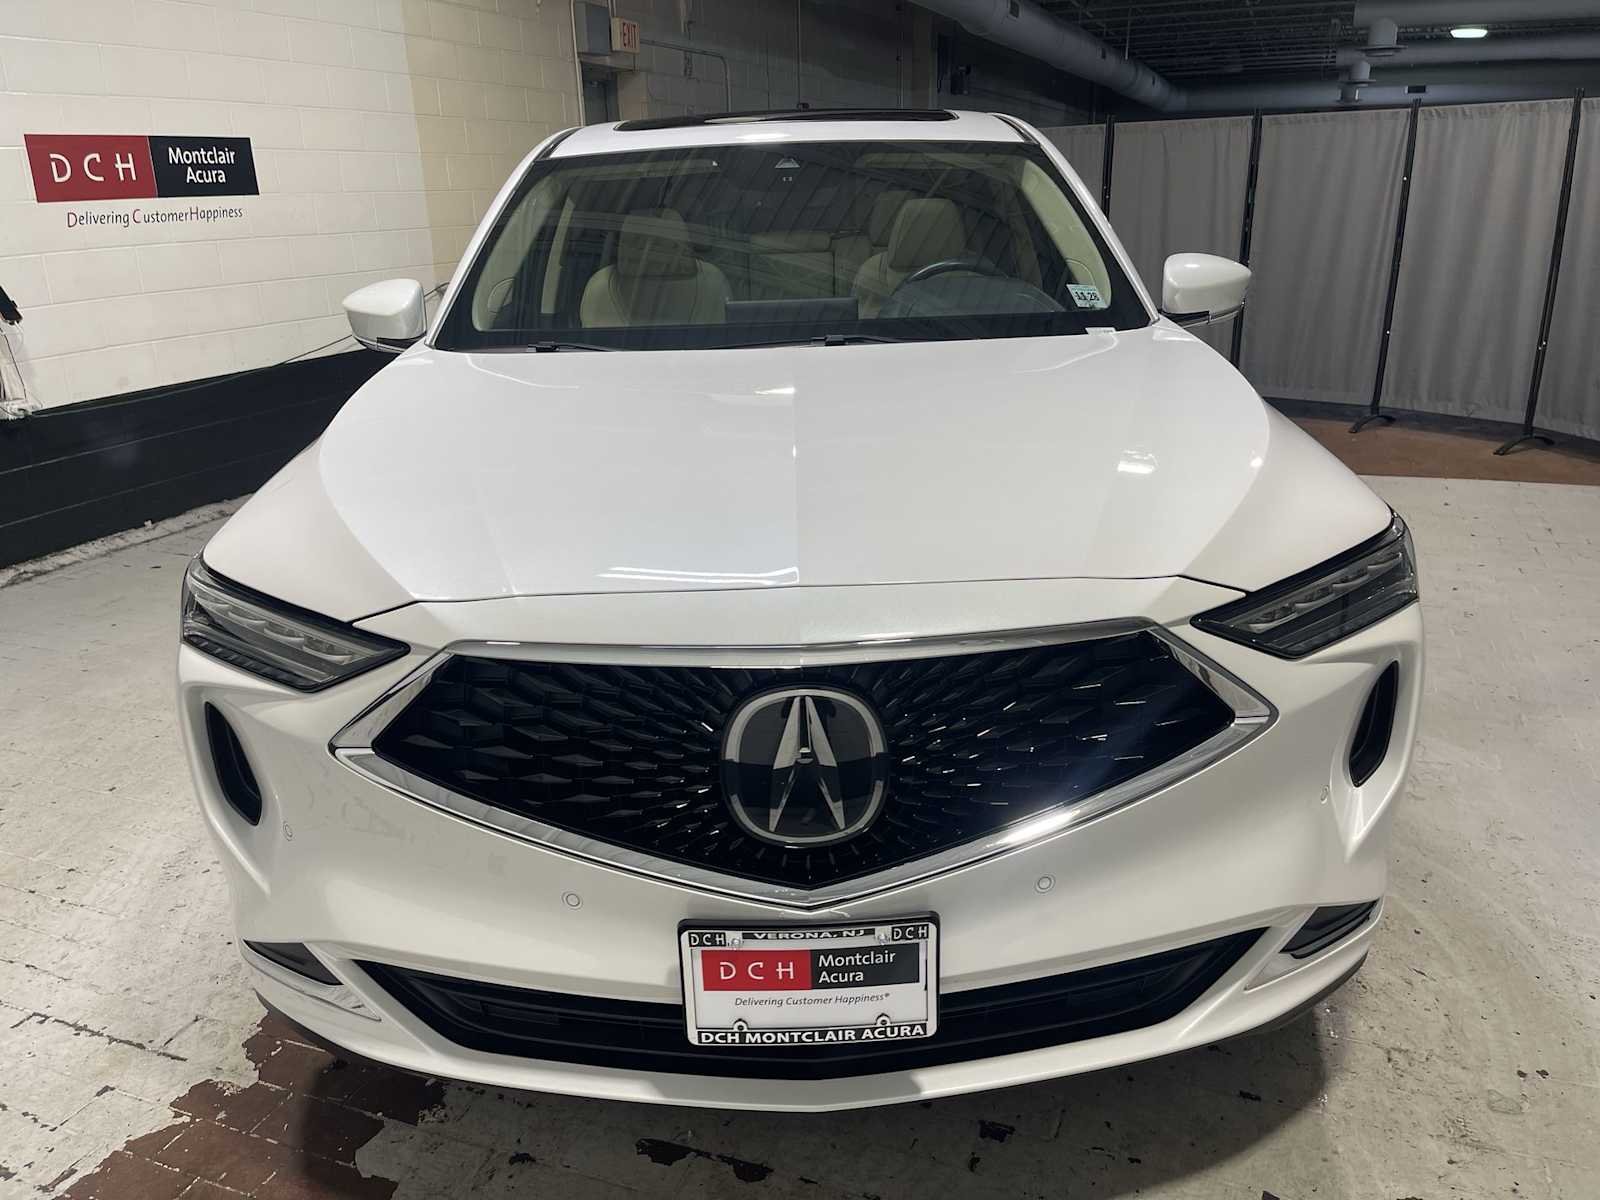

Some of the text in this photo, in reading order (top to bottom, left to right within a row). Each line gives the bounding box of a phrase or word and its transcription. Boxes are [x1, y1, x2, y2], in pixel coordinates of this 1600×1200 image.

[622, 22, 637, 48] EXIT
[168, 147, 235, 165] Montclair
[186, 166, 226, 183] Acura
[67, 210, 130, 228] Delivering
[690, 933, 725, 946] DCH
[842, 929, 865, 937] NJ
[893, 926, 928, 940] DCH
[818, 950, 896, 968] Montclair
[818, 971, 864, 984] Acura
[735, 997, 783, 1007] Delivering
[785, 996, 832, 1006] Customer
[701, 1024, 925, 1044] DCH MONTCLAIR ACURA
